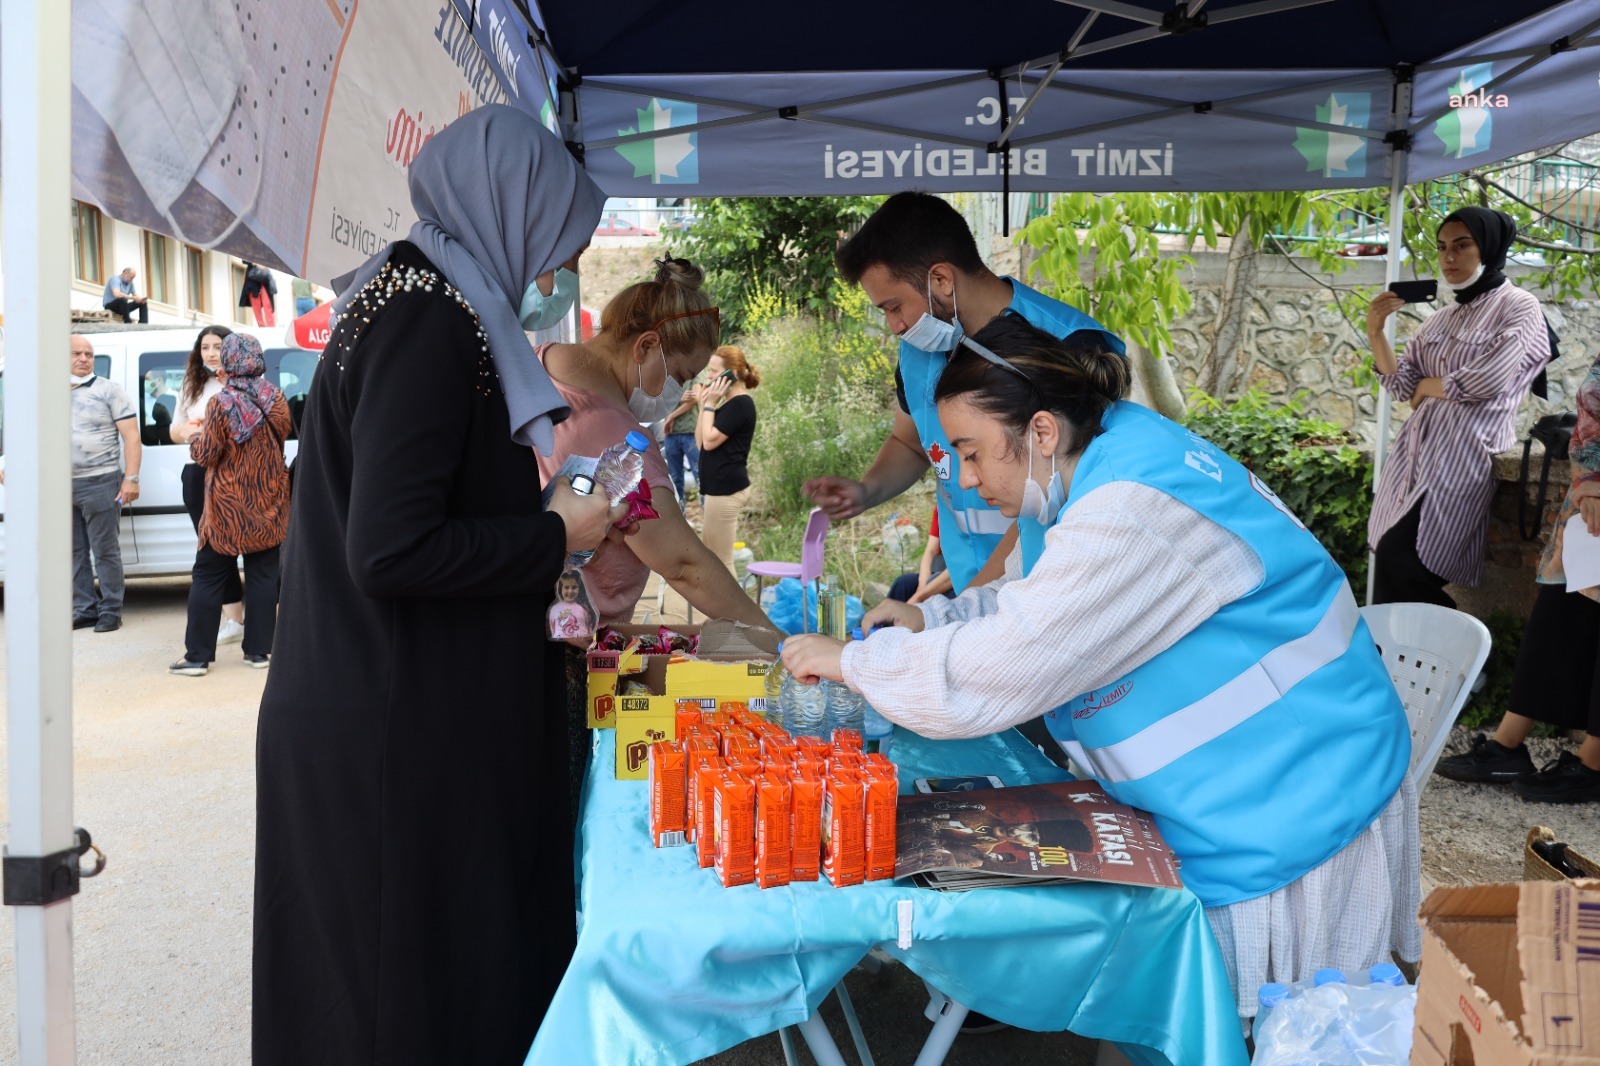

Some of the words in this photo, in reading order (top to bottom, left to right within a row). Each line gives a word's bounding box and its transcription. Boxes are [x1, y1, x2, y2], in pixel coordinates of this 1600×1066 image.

[308, 327, 332, 344] ALG
[627, 698, 649, 710] 48372
[1090, 812, 1134, 866] KAFASI
[1037, 845, 1070, 865] 100
